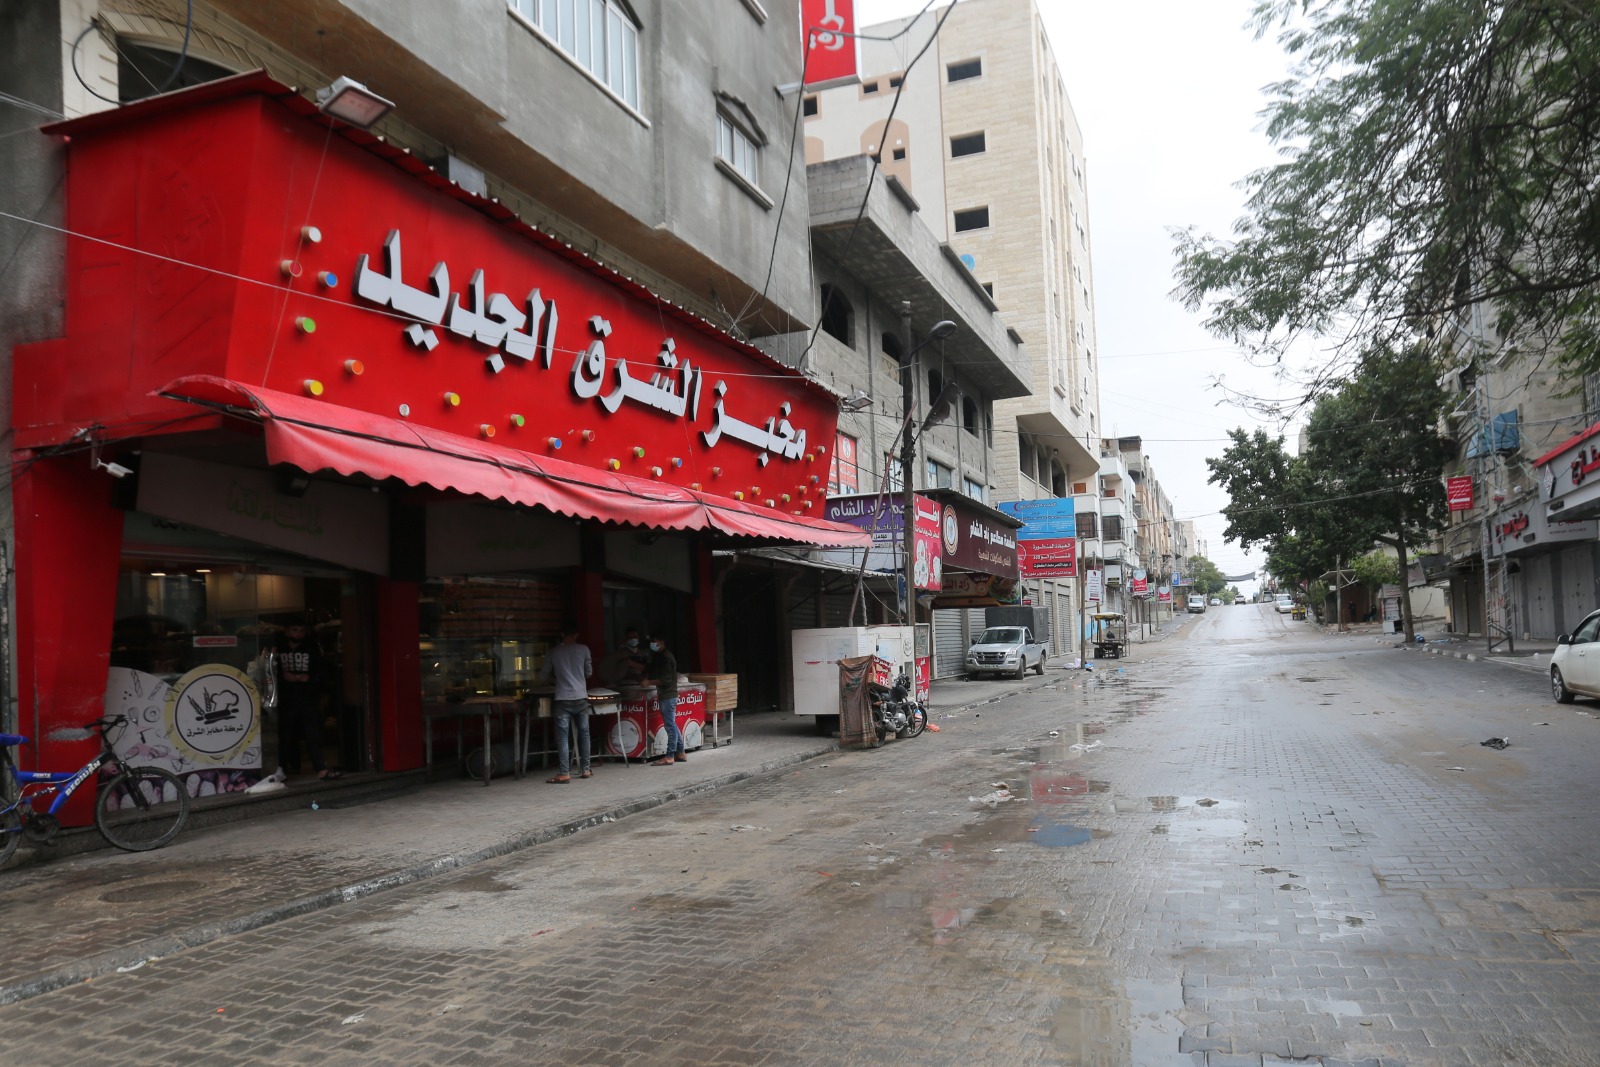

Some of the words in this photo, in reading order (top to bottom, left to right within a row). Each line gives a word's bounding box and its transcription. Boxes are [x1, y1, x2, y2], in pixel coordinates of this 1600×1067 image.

[352, 229, 559, 374] الجديد
[571, 315, 703, 422] الشرق
[703, 381, 808, 467] مخبز
[830, 499, 865, 520] الشام
[969, 519, 983, 539] الشام
[686, 692, 703, 705] شركة
[186, 727, 206, 738] الشرق
[206, 726, 223, 736] مخابز
[224, 724, 244, 736] شركة
